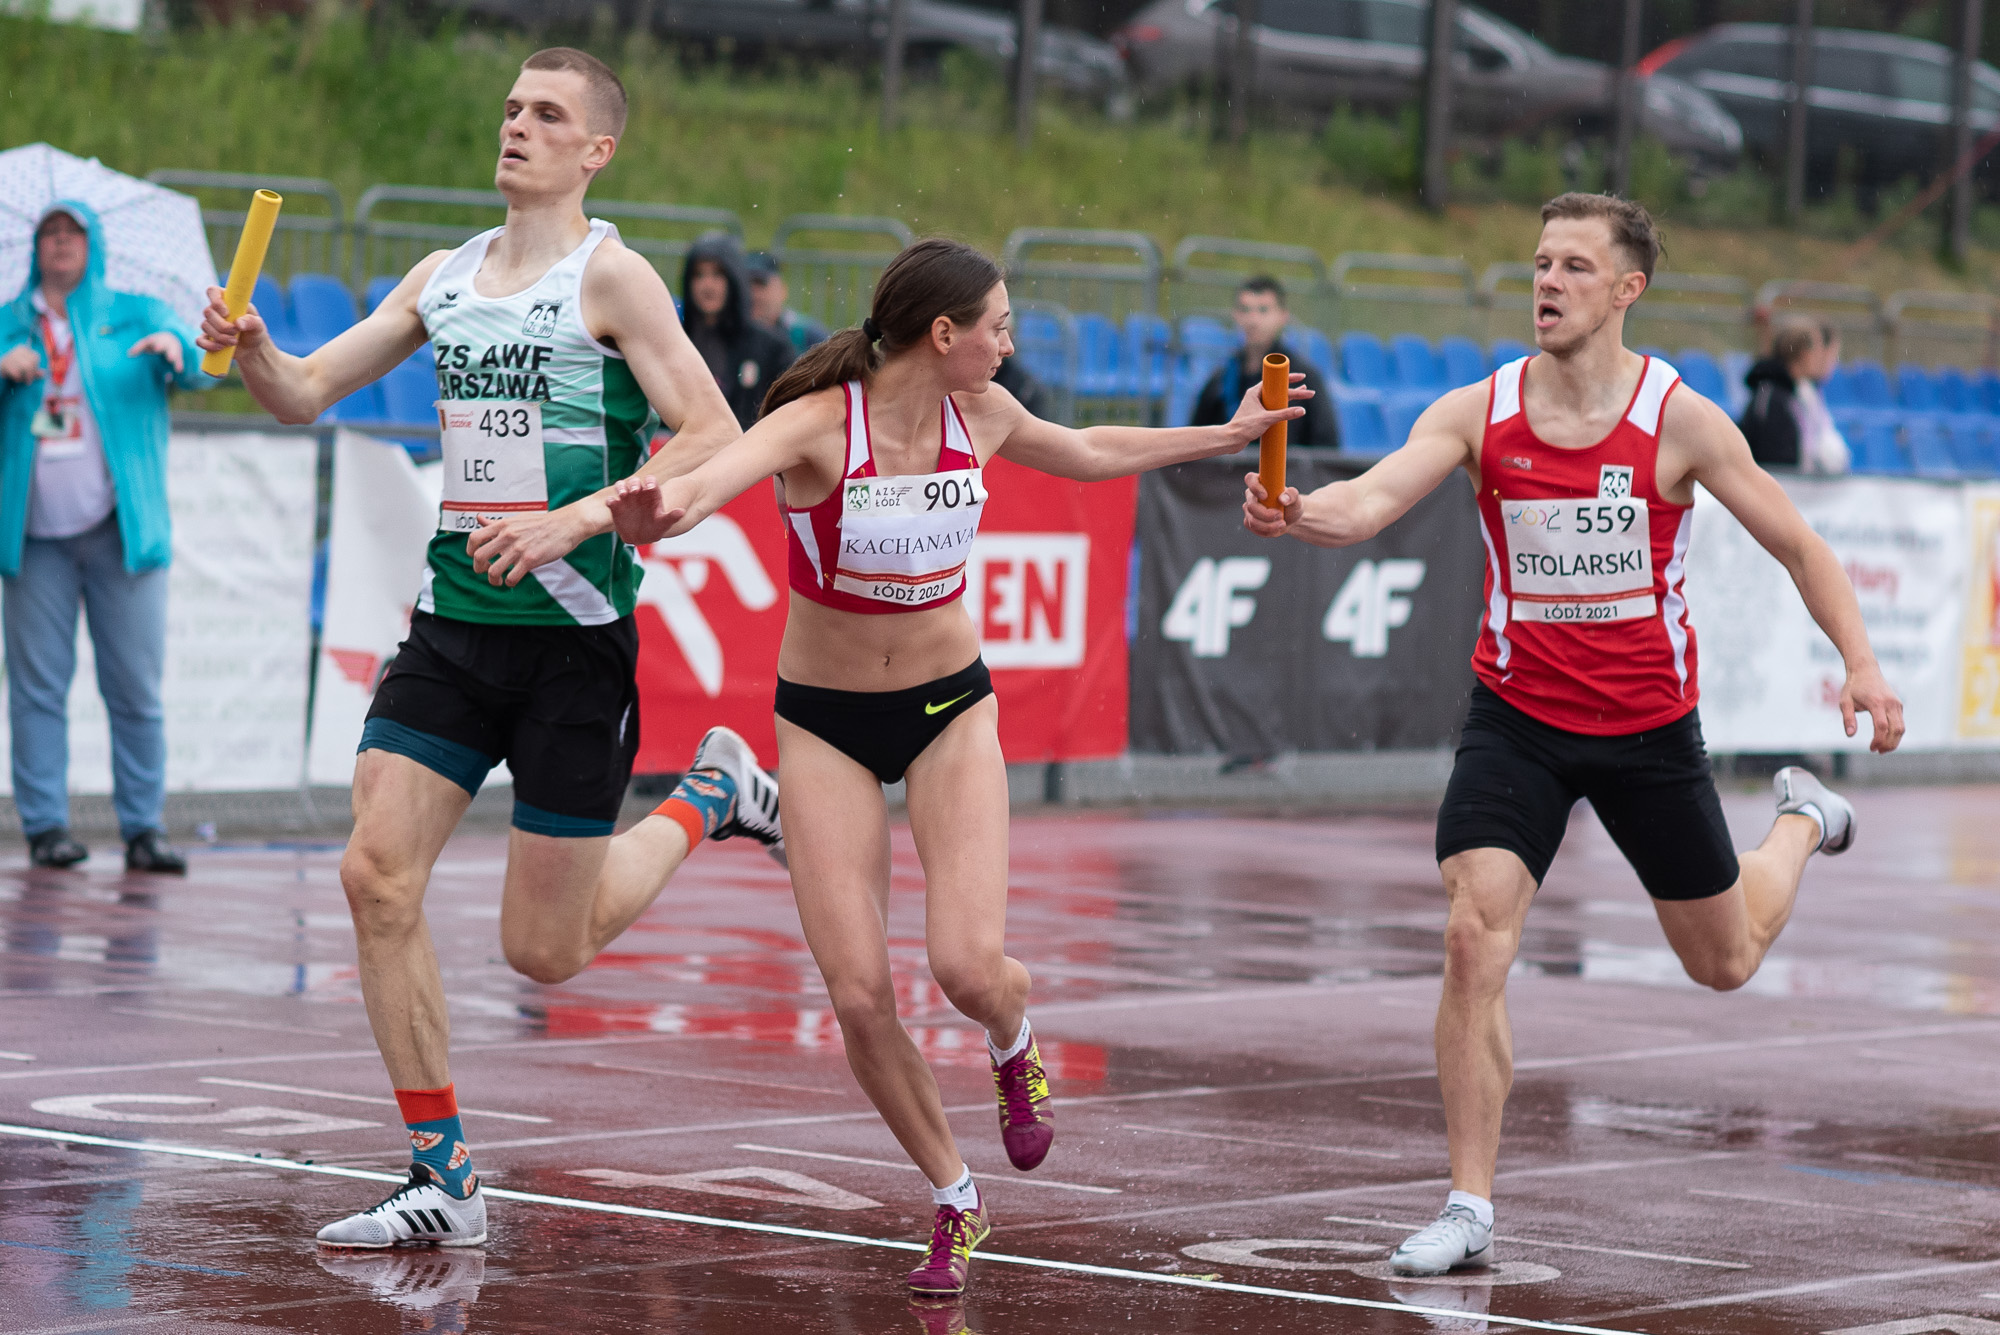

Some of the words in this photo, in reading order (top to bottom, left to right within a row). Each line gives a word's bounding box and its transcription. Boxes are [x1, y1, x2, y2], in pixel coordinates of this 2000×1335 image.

[480, 344, 553, 371] AWF
[479, 409, 530, 437] 433
[464, 459, 495, 482] LEC
[924, 477, 978, 511] 901
[1576, 506, 1636, 533] 559
[845, 526, 974, 555] KACHANAVA
[1516, 549, 1643, 577] STOLARSKI
[873, 583, 915, 601] ŁÓDŹ
[918, 583, 945, 601] 2021
[1160, 556, 1272, 658] 4F
[1321, 558, 1427, 658] 4F
[1544, 603, 1582, 620] ŁÓDŹ
[1586, 605, 1618, 619] 2021
